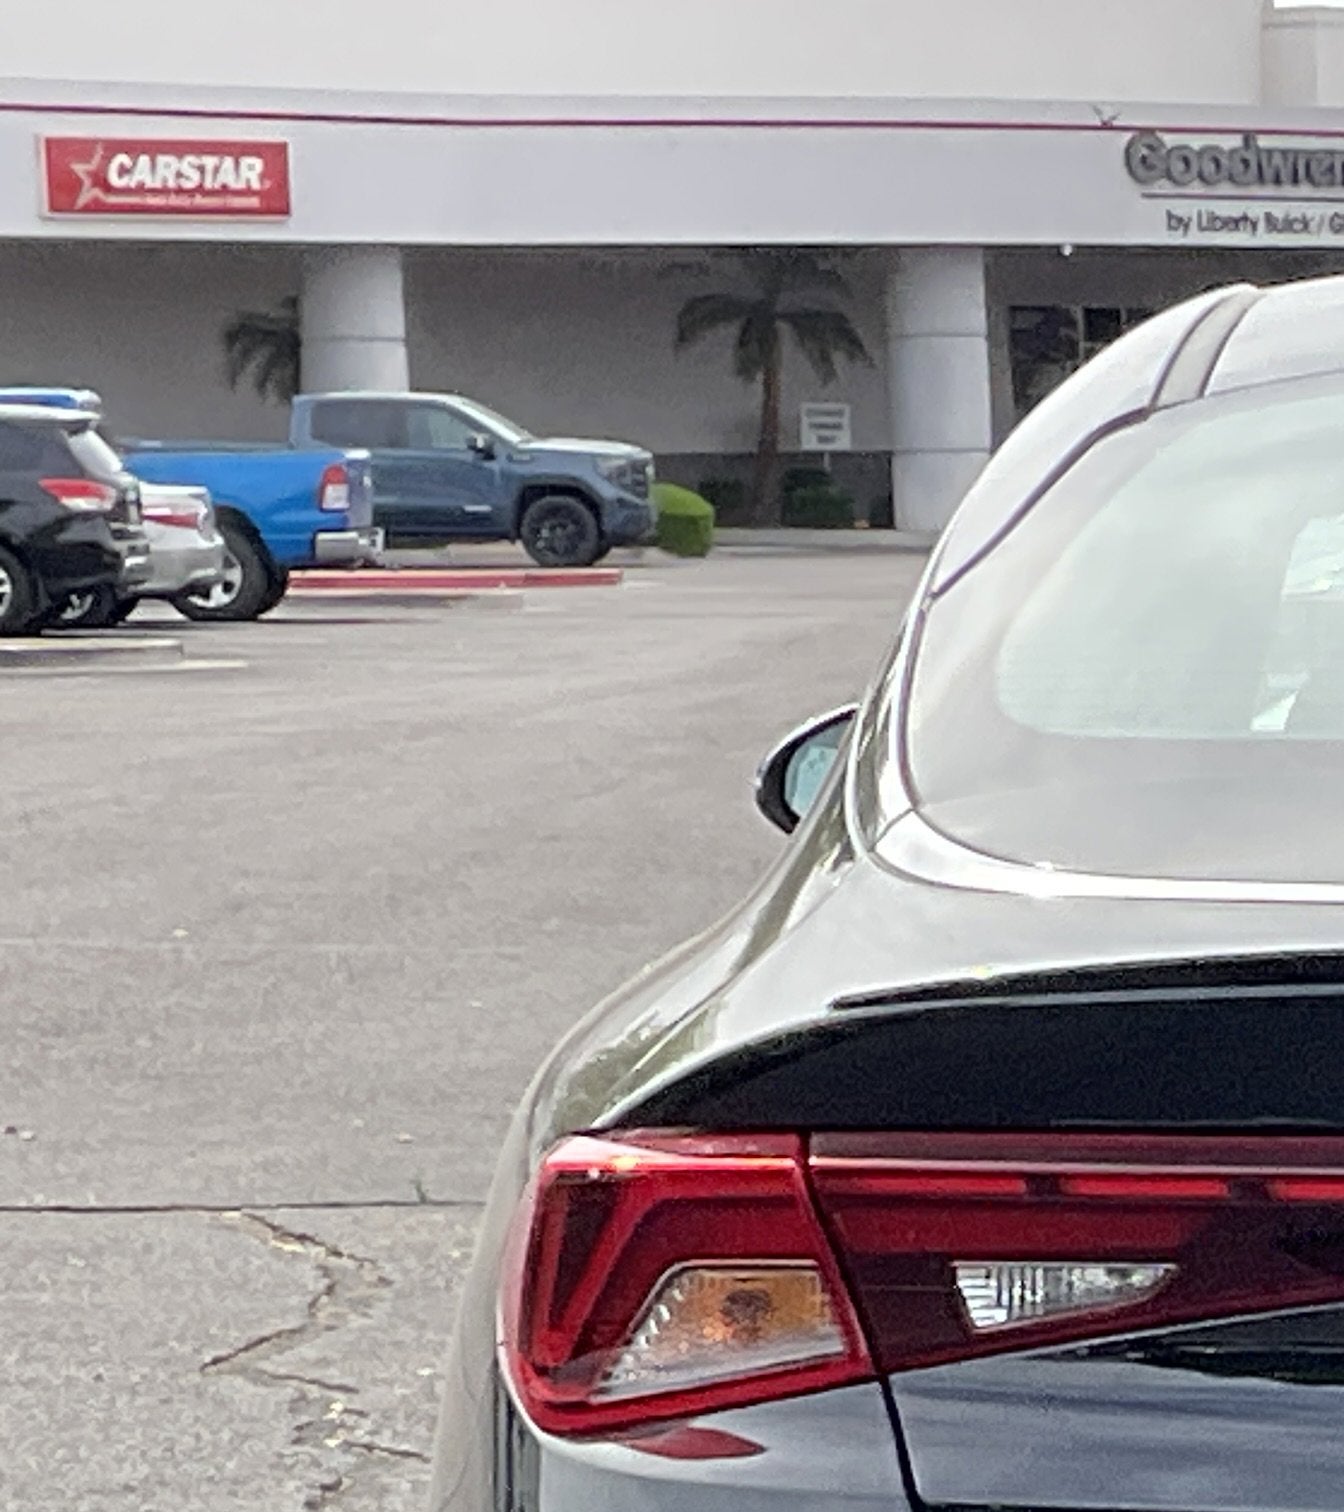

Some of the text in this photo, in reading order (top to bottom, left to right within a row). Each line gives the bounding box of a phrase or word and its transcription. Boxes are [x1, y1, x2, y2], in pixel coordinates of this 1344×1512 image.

[107, 153, 264, 190] CARSTAR
[1166, 209, 1191, 237] by
[1197, 210, 1259, 236] Liberty
